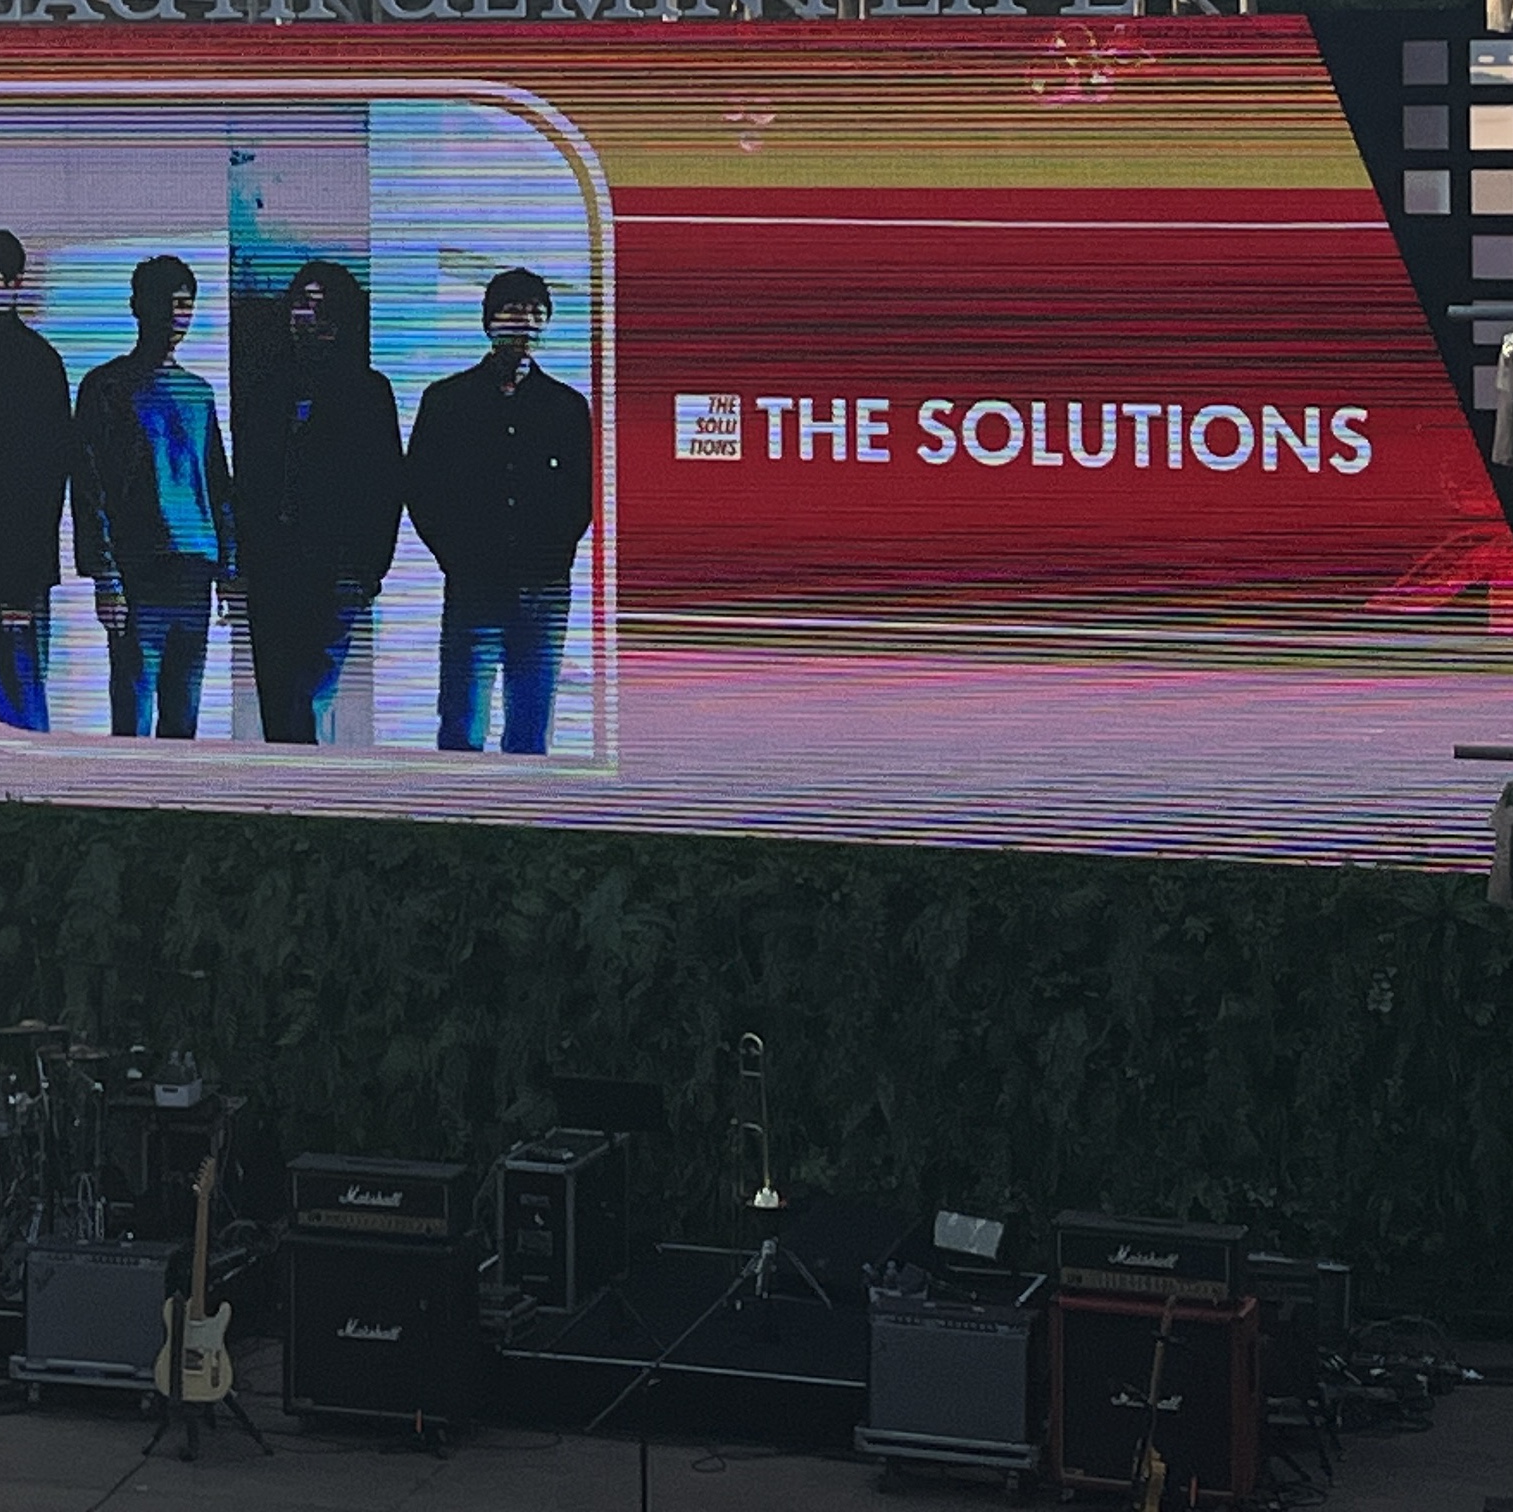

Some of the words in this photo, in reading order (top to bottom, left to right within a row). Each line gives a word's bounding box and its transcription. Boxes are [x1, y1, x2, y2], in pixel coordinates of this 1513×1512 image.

[709, 396, 738, 414] THE
[756, 396, 891, 464] THE
[916, 398, 1373, 475] SOLUTIONS
